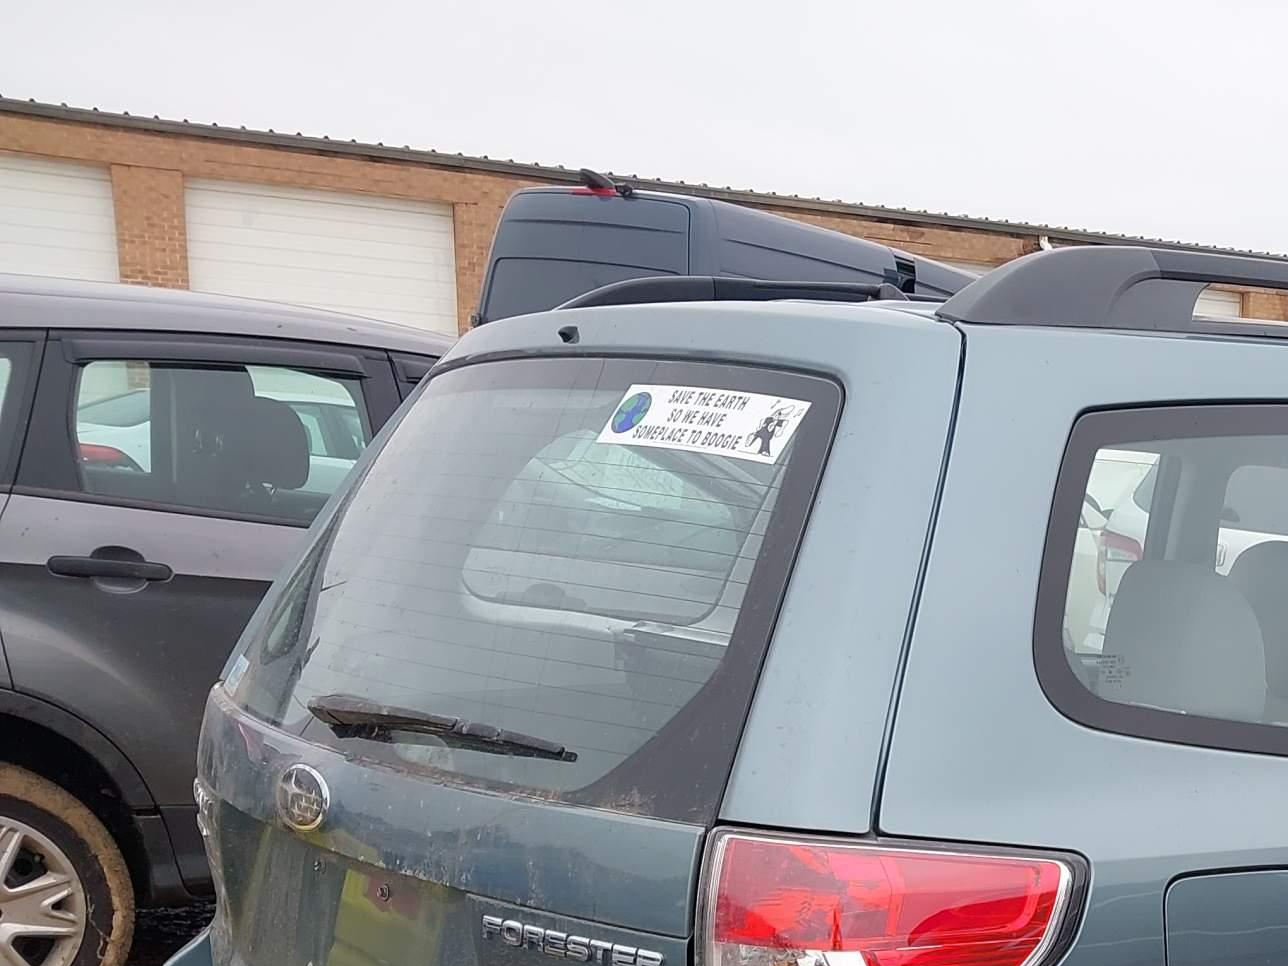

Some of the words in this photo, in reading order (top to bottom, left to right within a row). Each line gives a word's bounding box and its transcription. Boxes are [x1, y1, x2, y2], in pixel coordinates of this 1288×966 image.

[668, 390, 695, 405] SAVE
[695, 392, 713, 407] THE
[713, 394, 750, 411] EARTH
[667, 408, 682, 423] SO
[682, 410, 699, 425] WE
[699, 412, 727, 428] HAVE
[632, 424, 688, 443] SOMEPLACE
[686, 430, 701, 444] TO
[700, 432, 742, 450] BOOGIE
